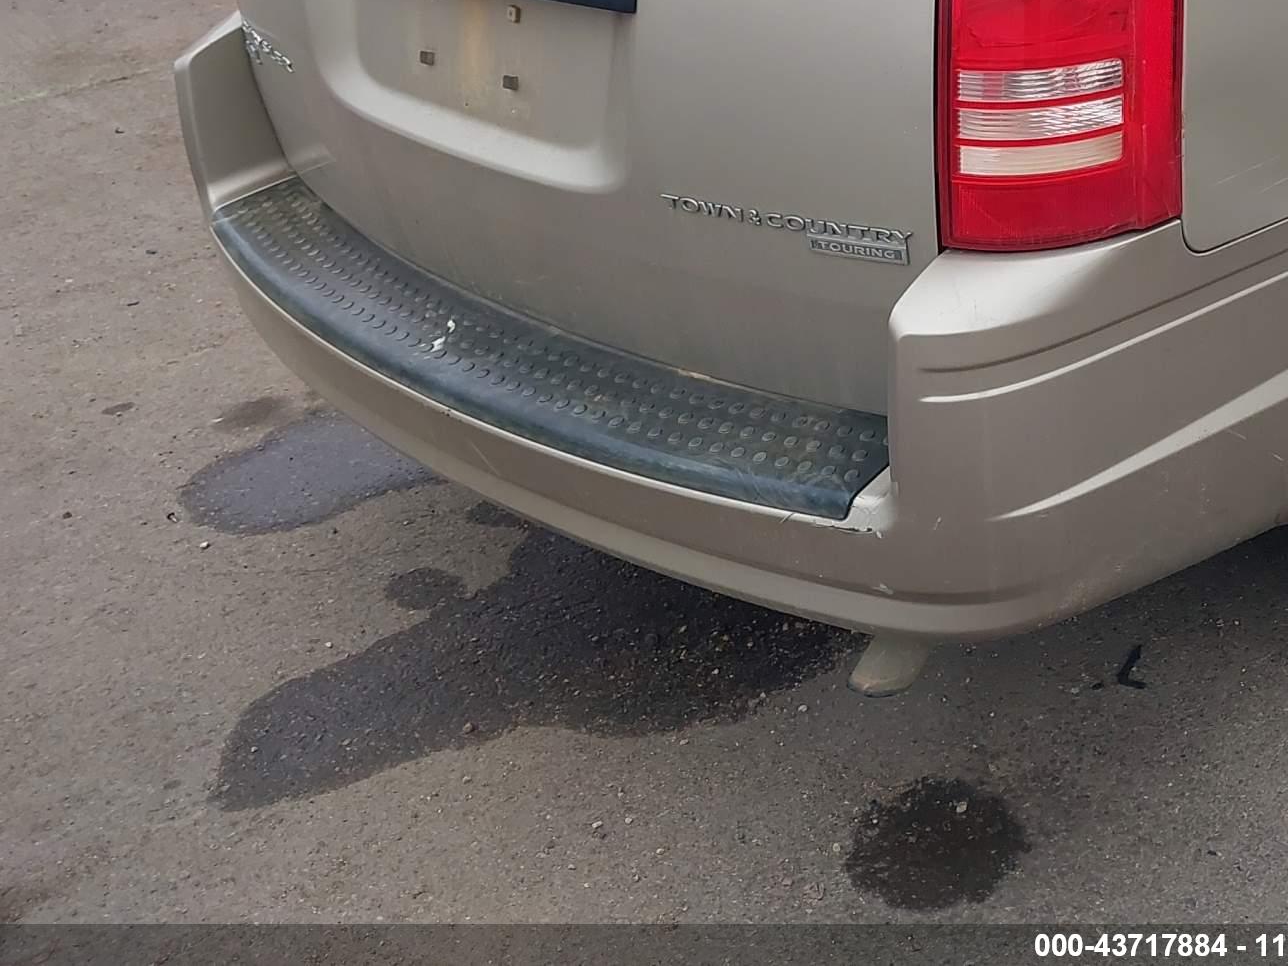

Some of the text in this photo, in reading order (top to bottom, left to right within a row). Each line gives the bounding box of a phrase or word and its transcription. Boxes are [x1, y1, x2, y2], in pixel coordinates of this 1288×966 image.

[660, 193, 913, 245] TOWN & COUNTRY
[818, 240, 896, 259] TOURING
